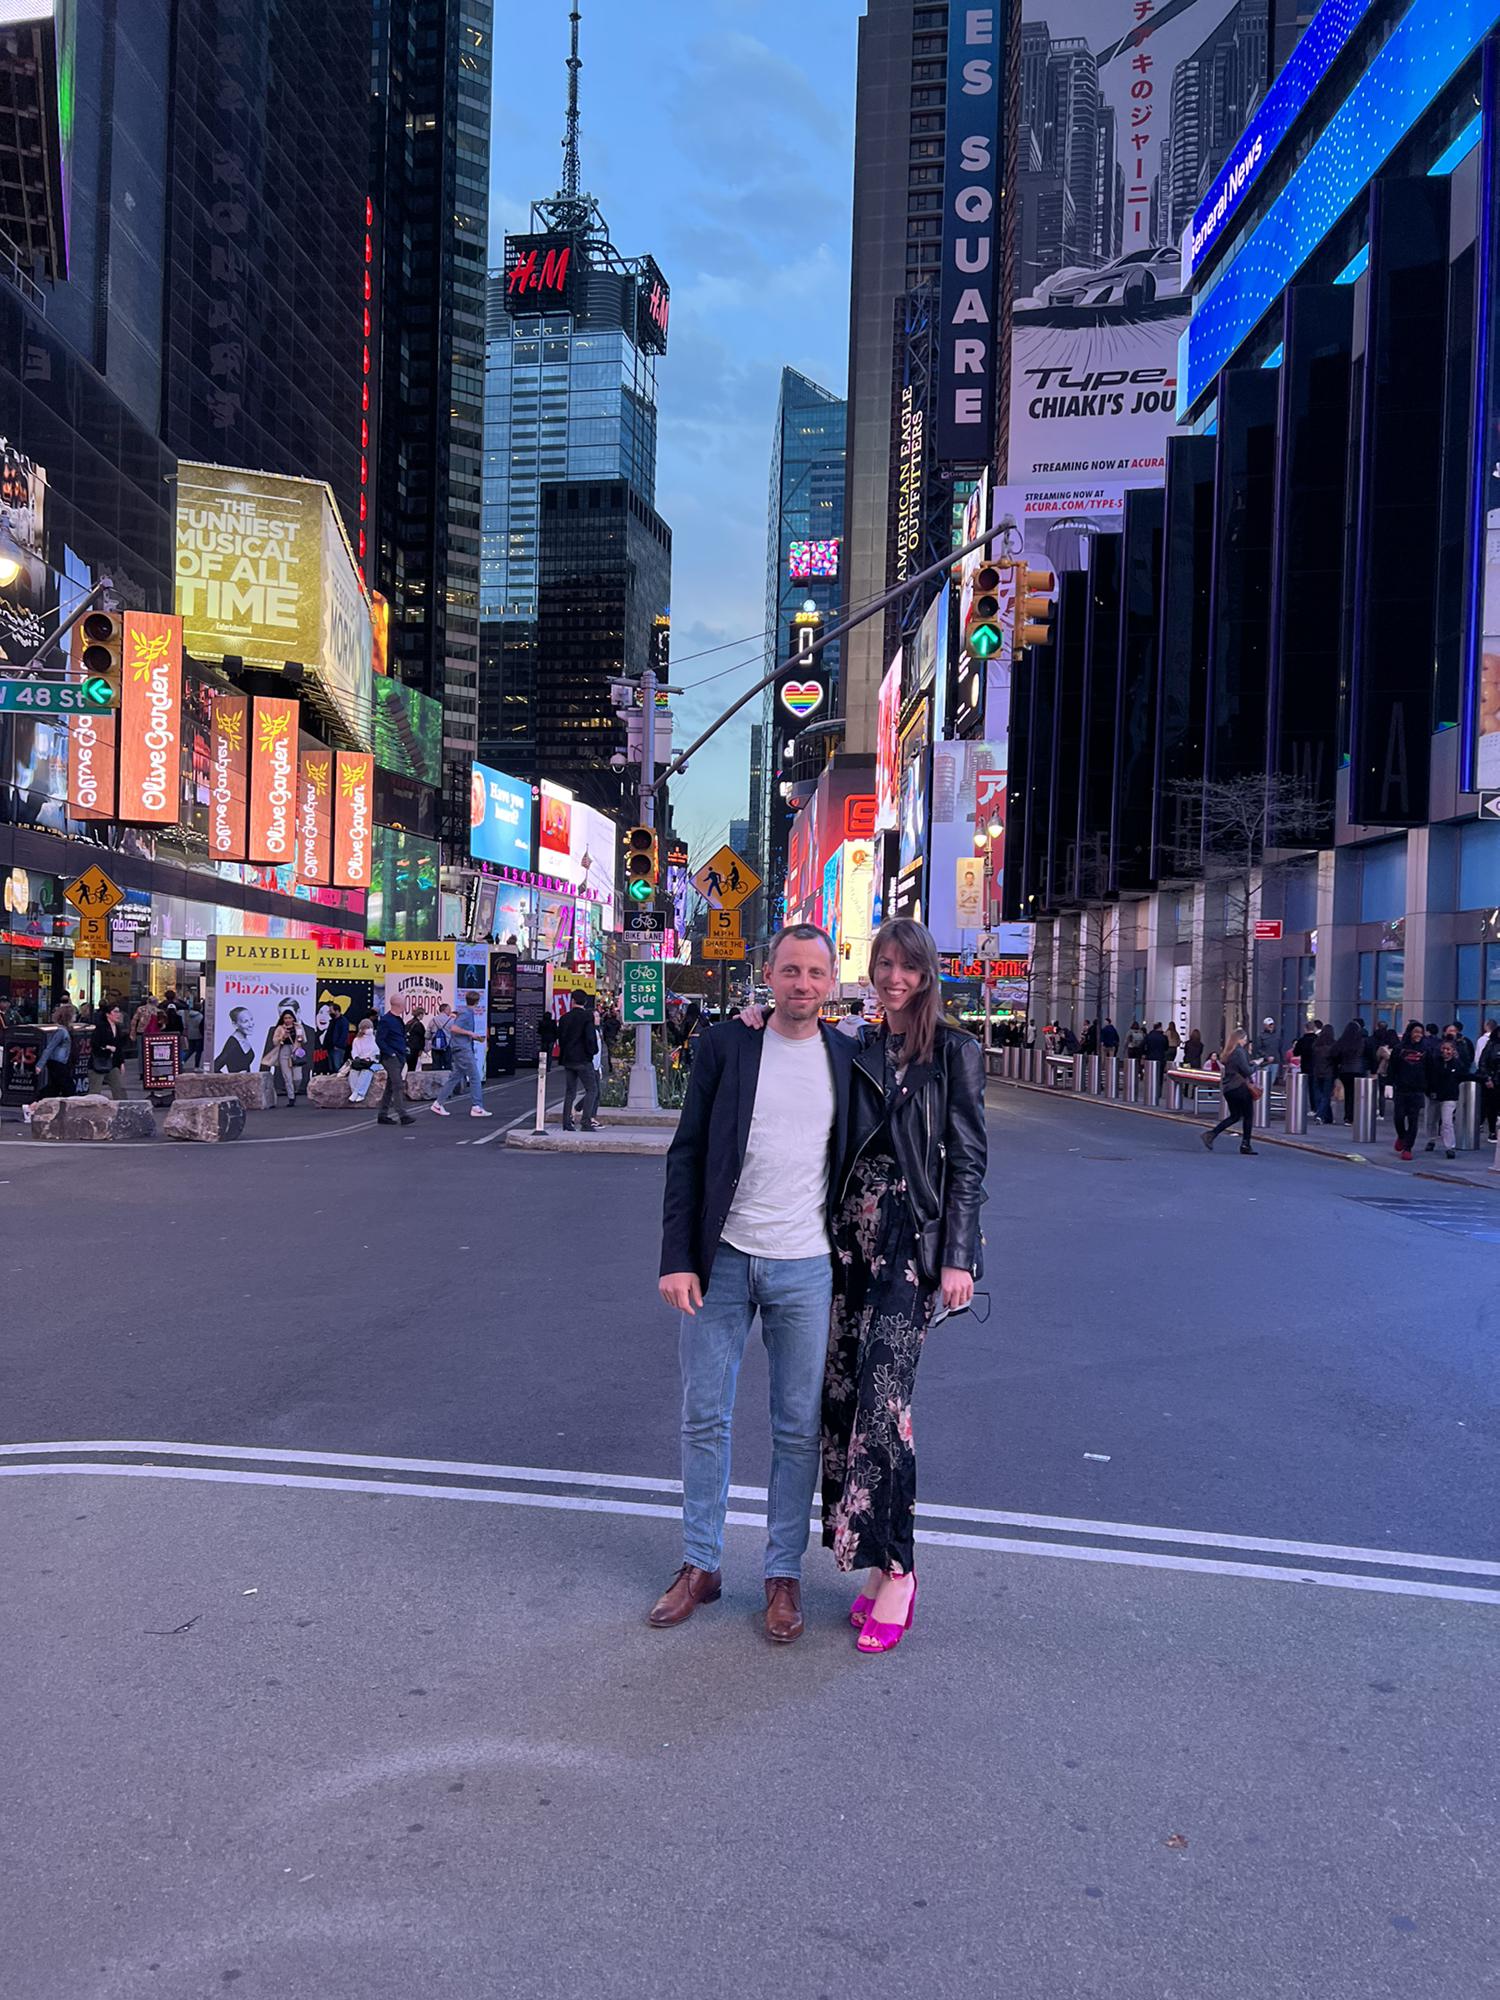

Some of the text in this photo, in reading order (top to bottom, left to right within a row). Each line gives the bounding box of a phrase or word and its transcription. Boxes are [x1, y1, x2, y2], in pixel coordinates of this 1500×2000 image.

[1228, 134, 1263, 203] News
[508, 247, 571, 295] H&M
[951, 135, 994, 424] SQUARE
[649, 280, 670, 339] H&M
[1024, 366, 1168, 392] Type
[1028, 392, 1125, 419] CHIAKI'S
[1031, 461, 1090, 473] STREAMING
[1090, 460, 1118, 471] NOW
[1117, 459, 1131, 469] AT
[897, 384, 913, 581] AMERICAN EAGLE
[908, 409, 924, 550] OUTFITTERS
[1024, 489, 1105, 502] STREAMING NOW AT
[1024, 498, 1124, 513] ACURA.COM/TYPE-S
[176, 506, 300, 542] FUNNIEST
[176, 527, 300, 564] MUSICAL
[176, 548, 299, 590] OF ALL
[15, 687, 52, 706] 48
[59, 688, 86, 708] St
[142, 663, 175, 811] Olive Garden
[266, 737, 292, 853] Olive Garden
[347, 784, 368, 880] Olive Garden
[538, 874, 599, 900] BROADAY
[88, 919, 99, 933] 5
[719, 912, 732, 928] 5
[625, 931, 663, 941] BIKE LANE
[705, 940, 743, 949] SHARE THE
[225, 945, 311, 960] PLAYBILL
[317, 956, 370, 969] AYBILL
[391, 949, 451, 961] PLAYBILL
[225, 981, 310, 996] Plaza Suite
[398, 975, 444, 994] LITTLE SHOP
[630, 983, 657, 993] East
[401, 995, 443, 1017] ORRORS
[630, 993, 657, 1003] Side
